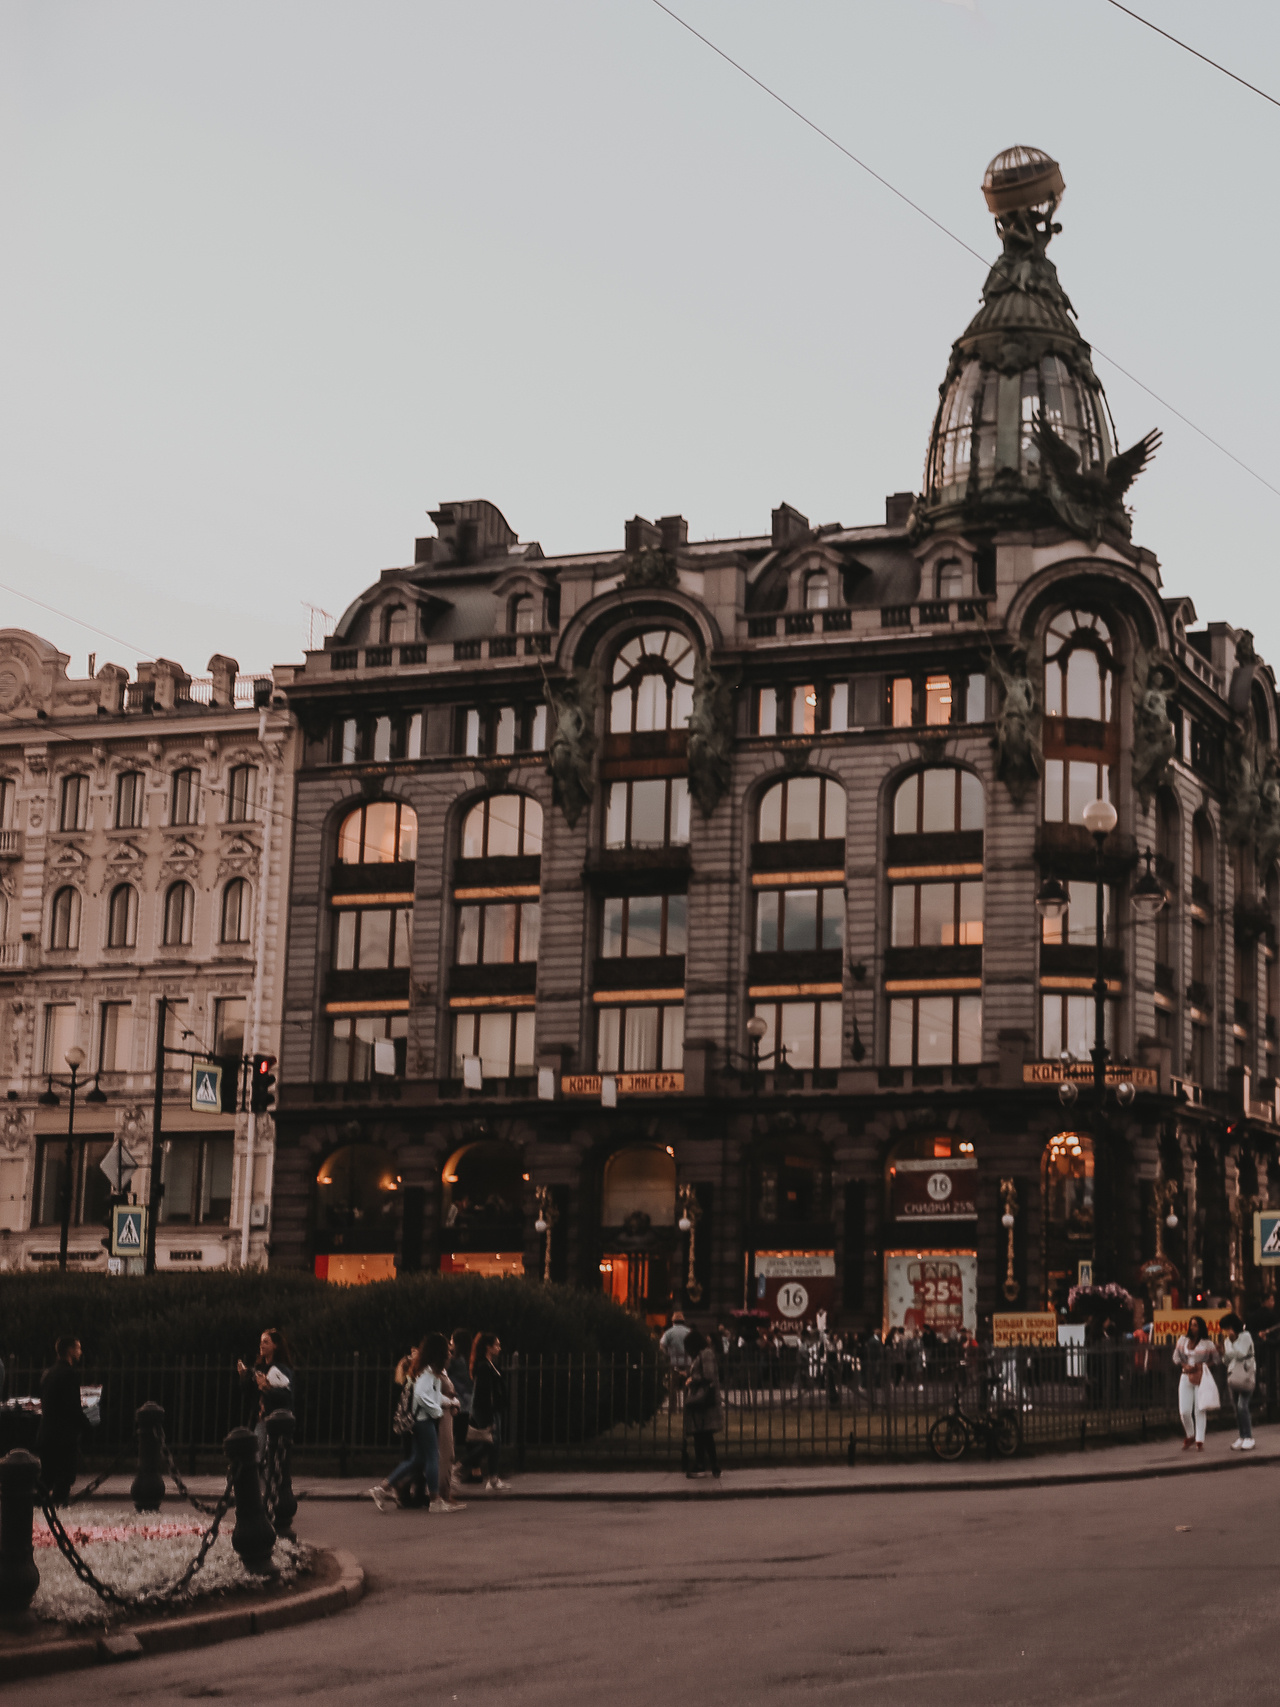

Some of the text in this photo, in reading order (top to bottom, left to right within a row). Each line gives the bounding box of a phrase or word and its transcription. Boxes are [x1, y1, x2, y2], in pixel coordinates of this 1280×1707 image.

[569, 1075, 623, 1093] КОМПЯ
[932, 1178, 948, 1192] 16
[783, 1287, 803, 1307] 16
[1155, 1320, 1224, 1334] КРОНАД
